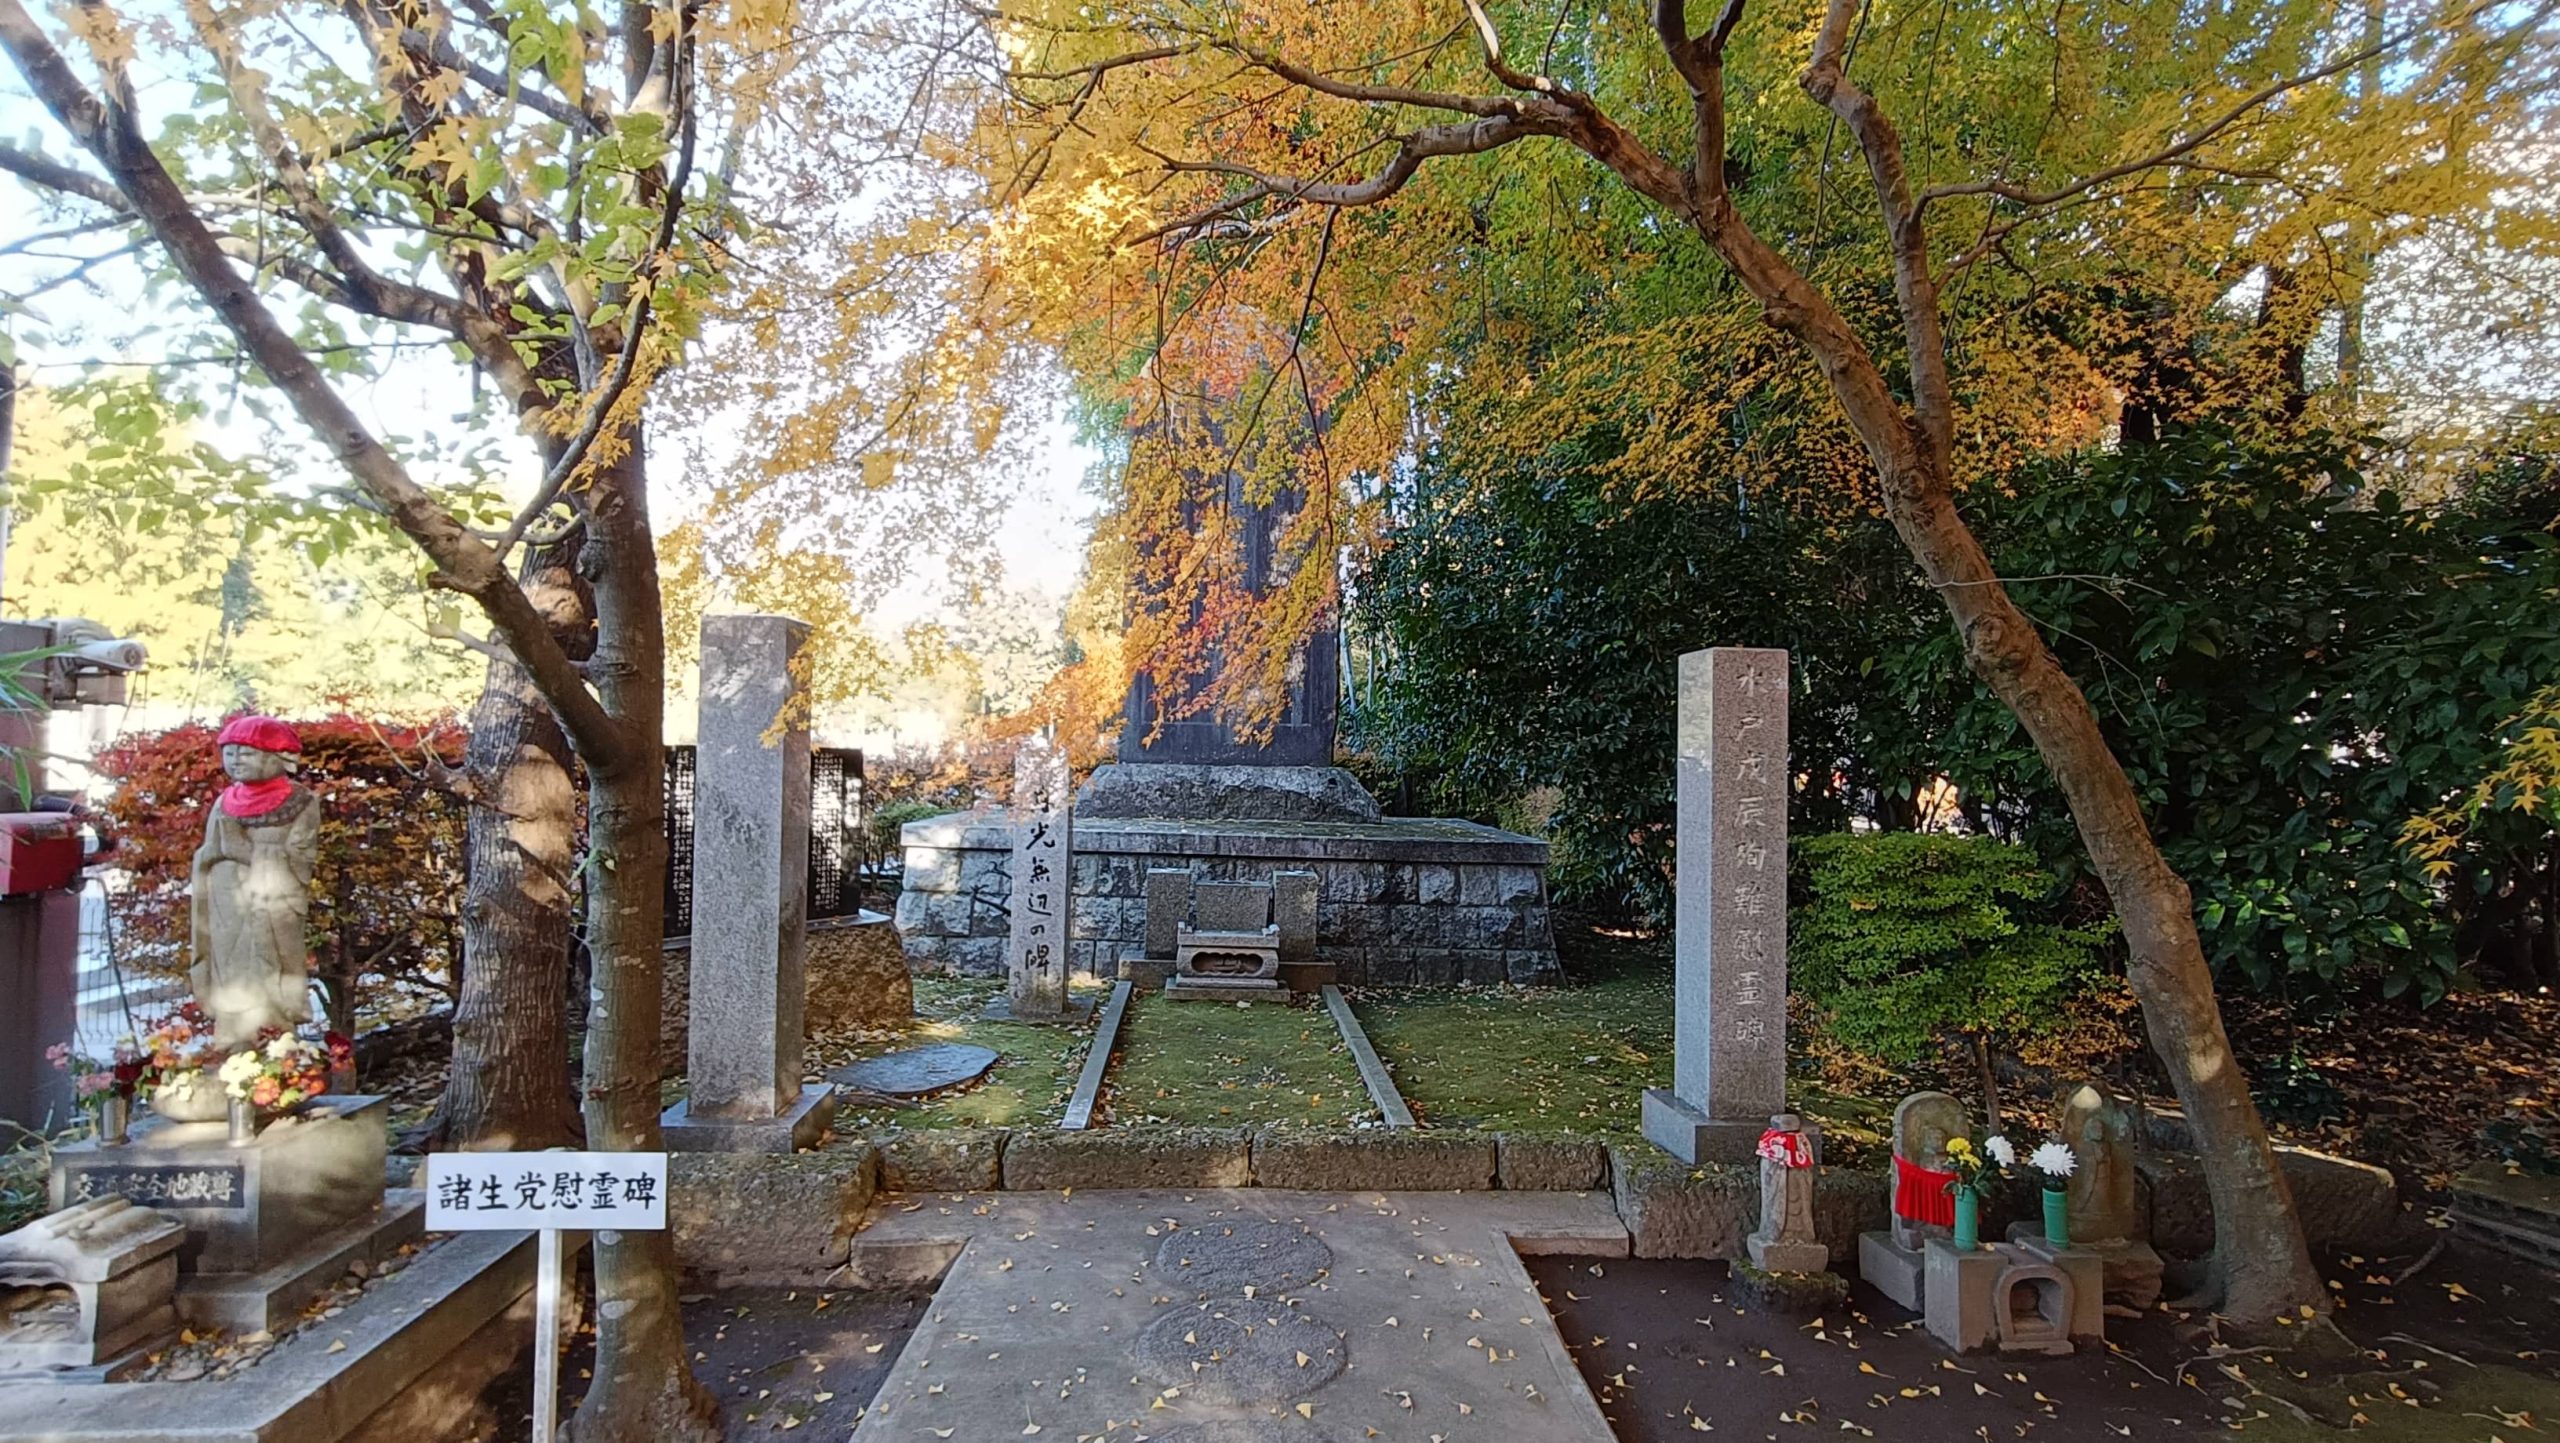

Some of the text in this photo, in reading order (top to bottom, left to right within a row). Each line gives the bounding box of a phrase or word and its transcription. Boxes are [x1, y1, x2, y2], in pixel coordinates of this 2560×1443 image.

[437, 1171, 658, 1211] 諸生党慰霊碑
